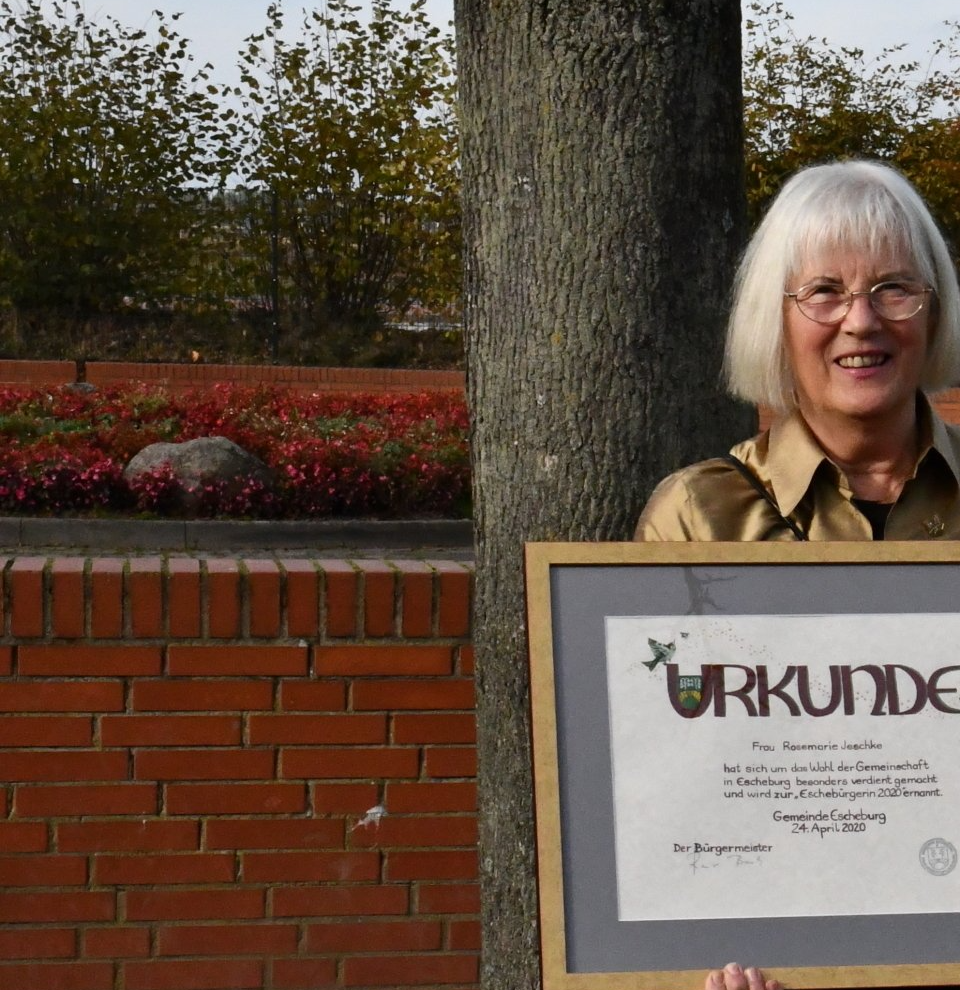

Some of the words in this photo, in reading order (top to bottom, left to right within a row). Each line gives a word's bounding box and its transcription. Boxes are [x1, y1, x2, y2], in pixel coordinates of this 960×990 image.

[752, 741, 775, 751] Frau
[783, 740, 838, 751] Rosemarie
[723, 763, 741, 773] hat
[745, 763, 767, 773] sich
[791, 762, 808, 773] das
[809, 761, 834, 772] Wohl
[837, 761, 854, 772] der
[855, 759, 929, 772] Gemeinschaft
[736, 777, 791, 790] Escheburg
[796, 776, 848, 786] besonders
[851, 775, 892, 785] verdient
[894, 774, 938, 788] gemacht
[723, 789, 744, 798] und
[747, 789, 771, 798] wird
[772, 810, 829, 822] Gemeinde
[830, 808, 887, 824] Escheburg
[791, 823, 810, 834] 24.
[811, 821, 840, 838] April
[842, 822, 866, 832] 2020
[673, 843, 691, 853] Der
[694, 842, 773, 855] Bürgermeister
